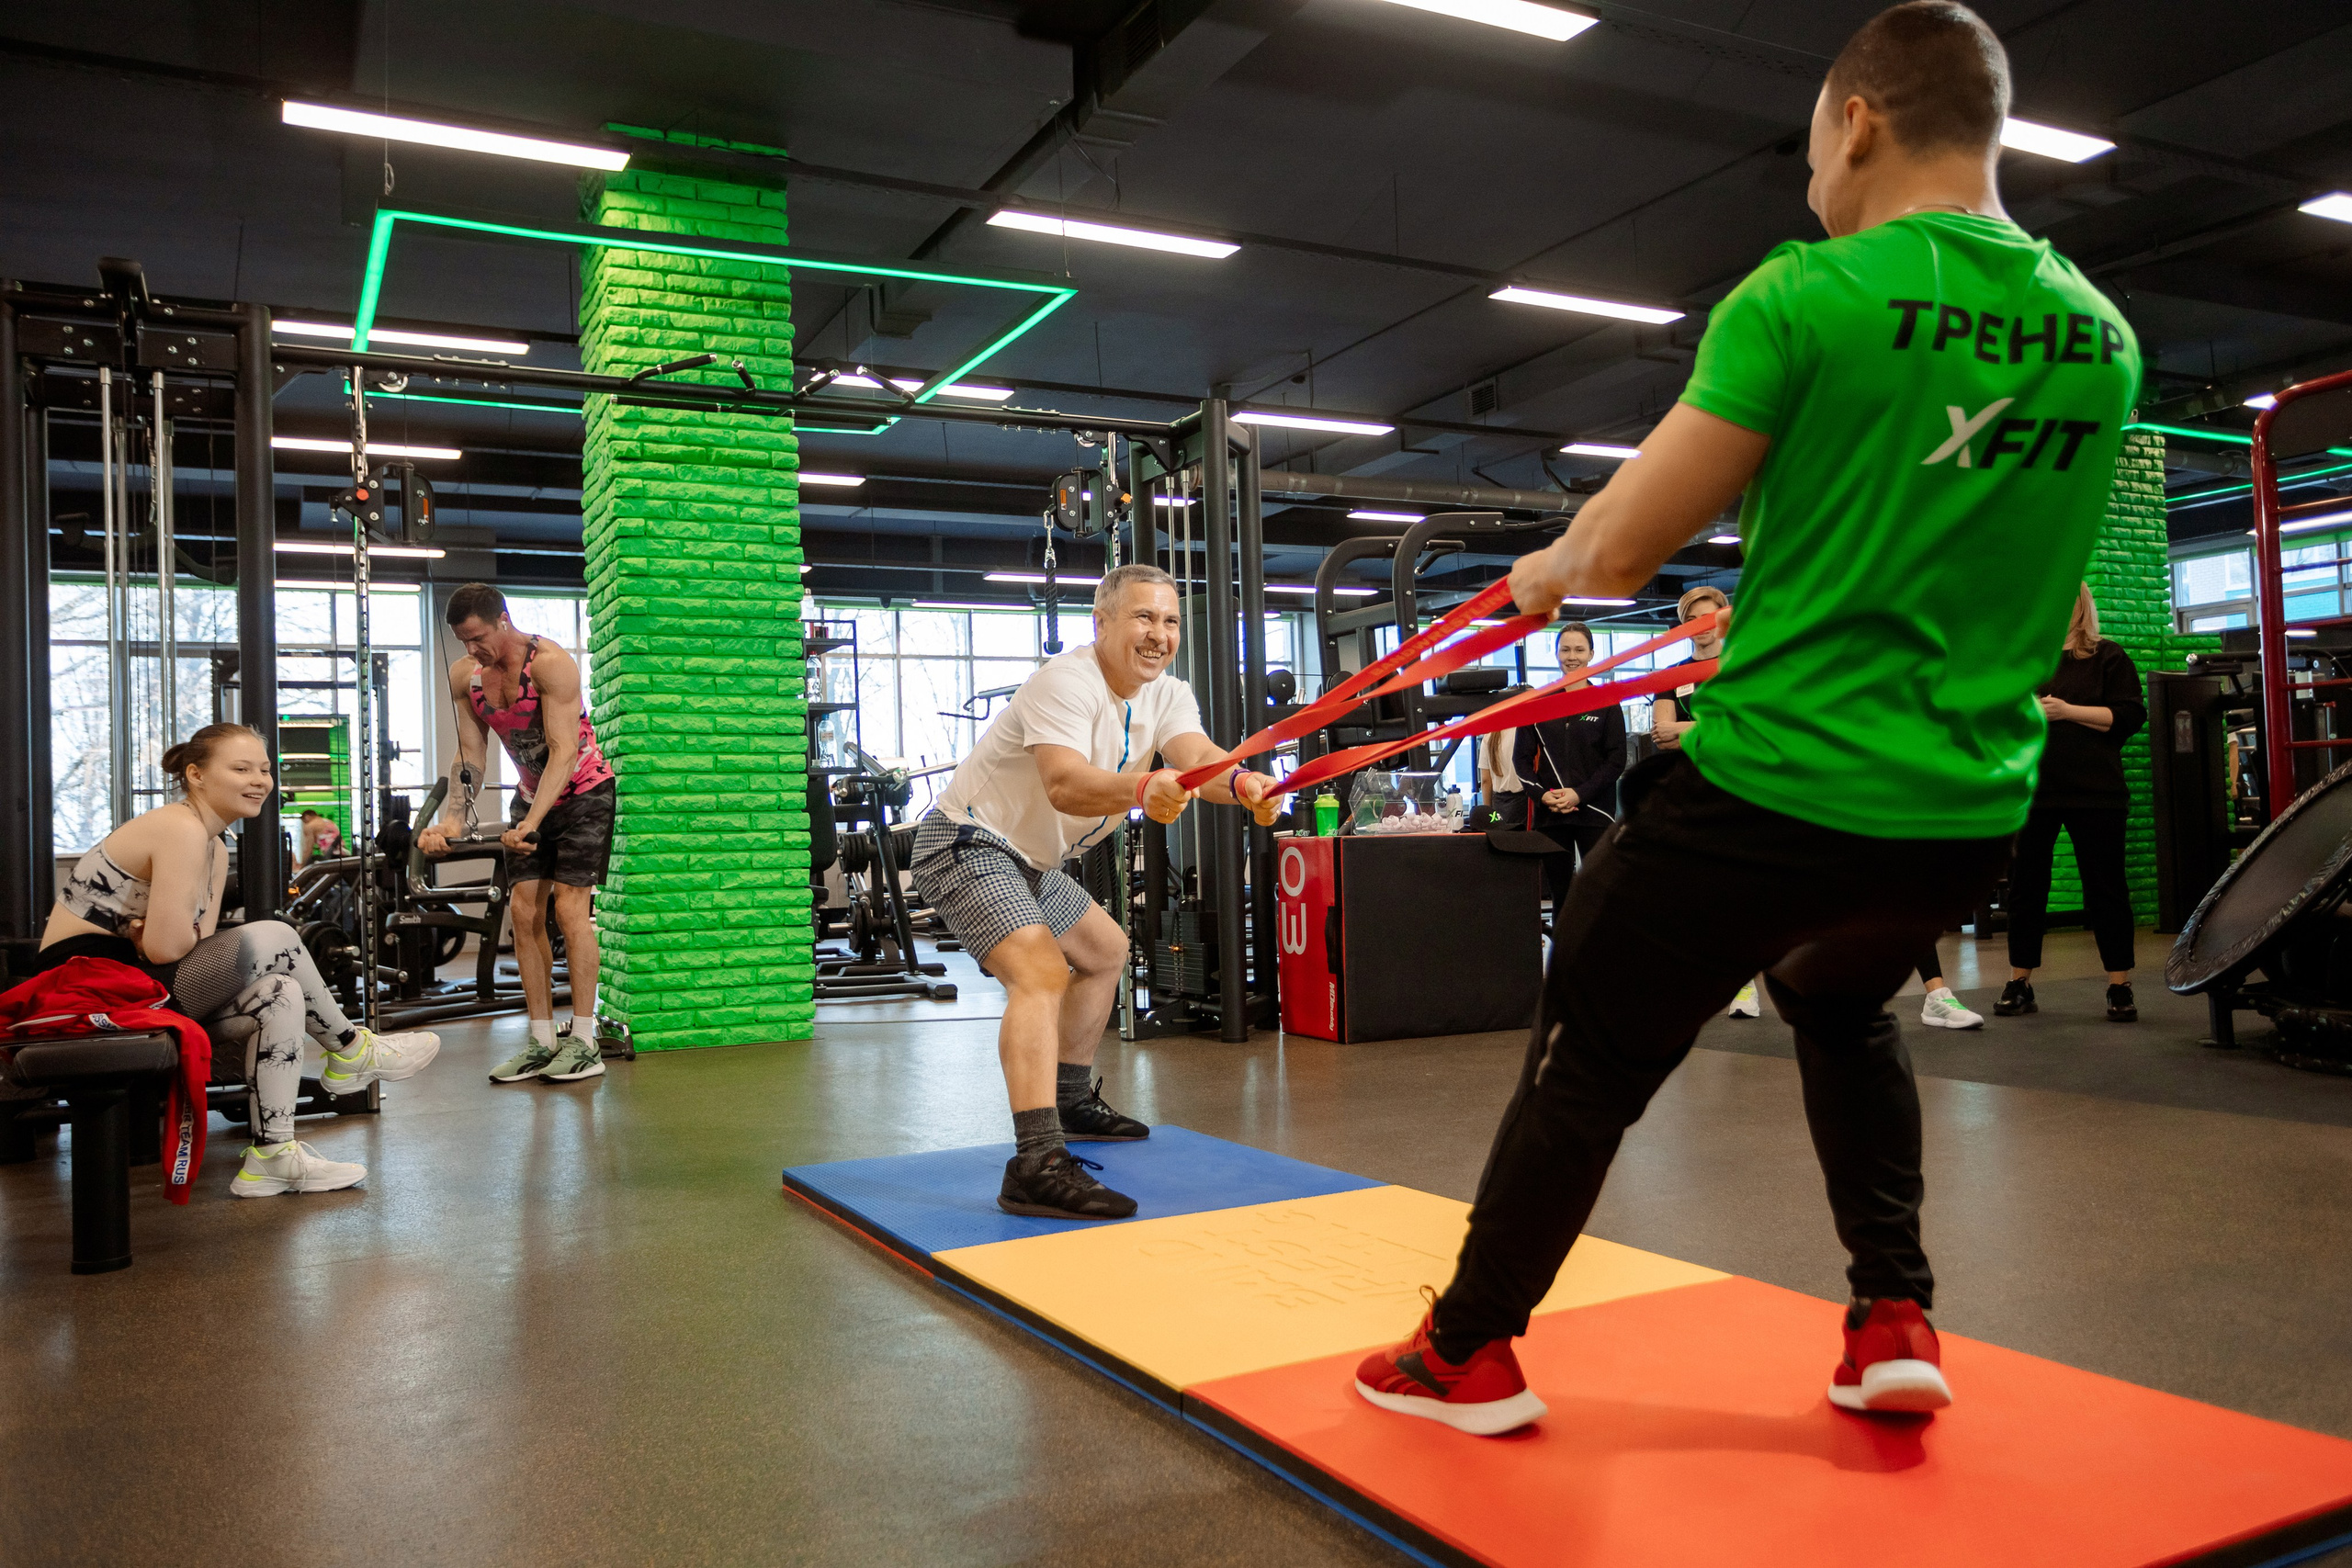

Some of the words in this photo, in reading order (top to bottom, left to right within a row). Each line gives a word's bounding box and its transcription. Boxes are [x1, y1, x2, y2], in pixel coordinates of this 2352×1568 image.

[1887, 299, 2124, 366] ТРЕНЕР
[1920, 397, 2100, 472] XFIT
[1579, 714, 1600, 723] XFIT
[178, 1124, 192, 1157] TEAM
[174, 1159, 188, 1184] RUS
